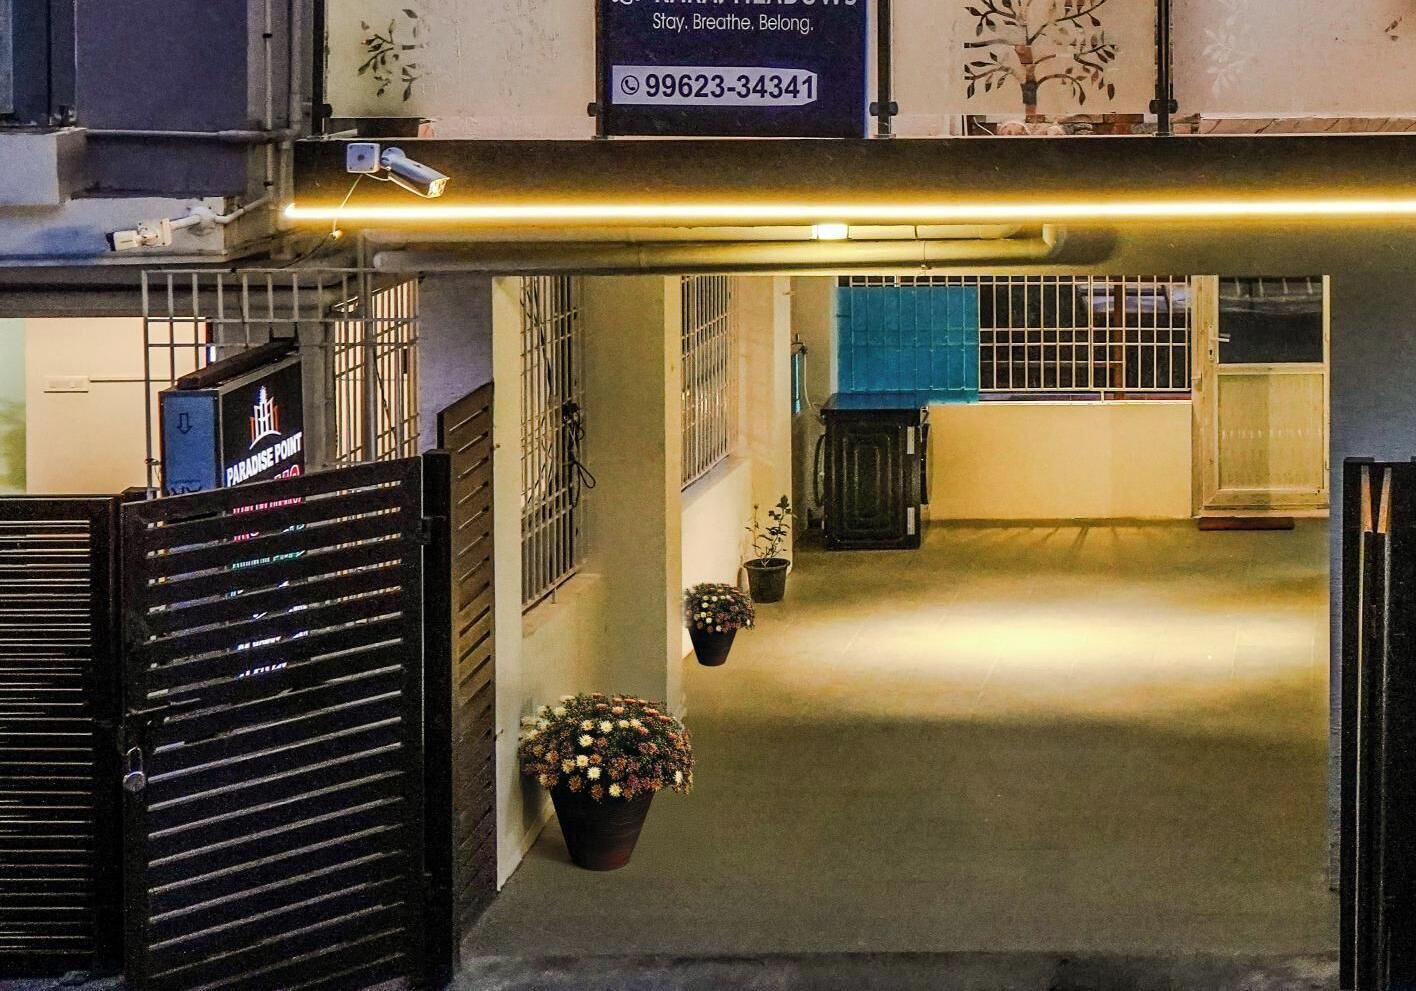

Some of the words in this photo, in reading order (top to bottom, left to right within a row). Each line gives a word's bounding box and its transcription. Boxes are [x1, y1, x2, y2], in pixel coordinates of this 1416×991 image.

[652, 12, 688, 33] Stay.
[693, 13, 754, 30] Breathe.
[759, 14, 814, 35] Belong.
[645, 73, 814, 99] 99623-34341
[226, 446, 274, 487] PARADISE
[274, 431, 302, 461] POINT
